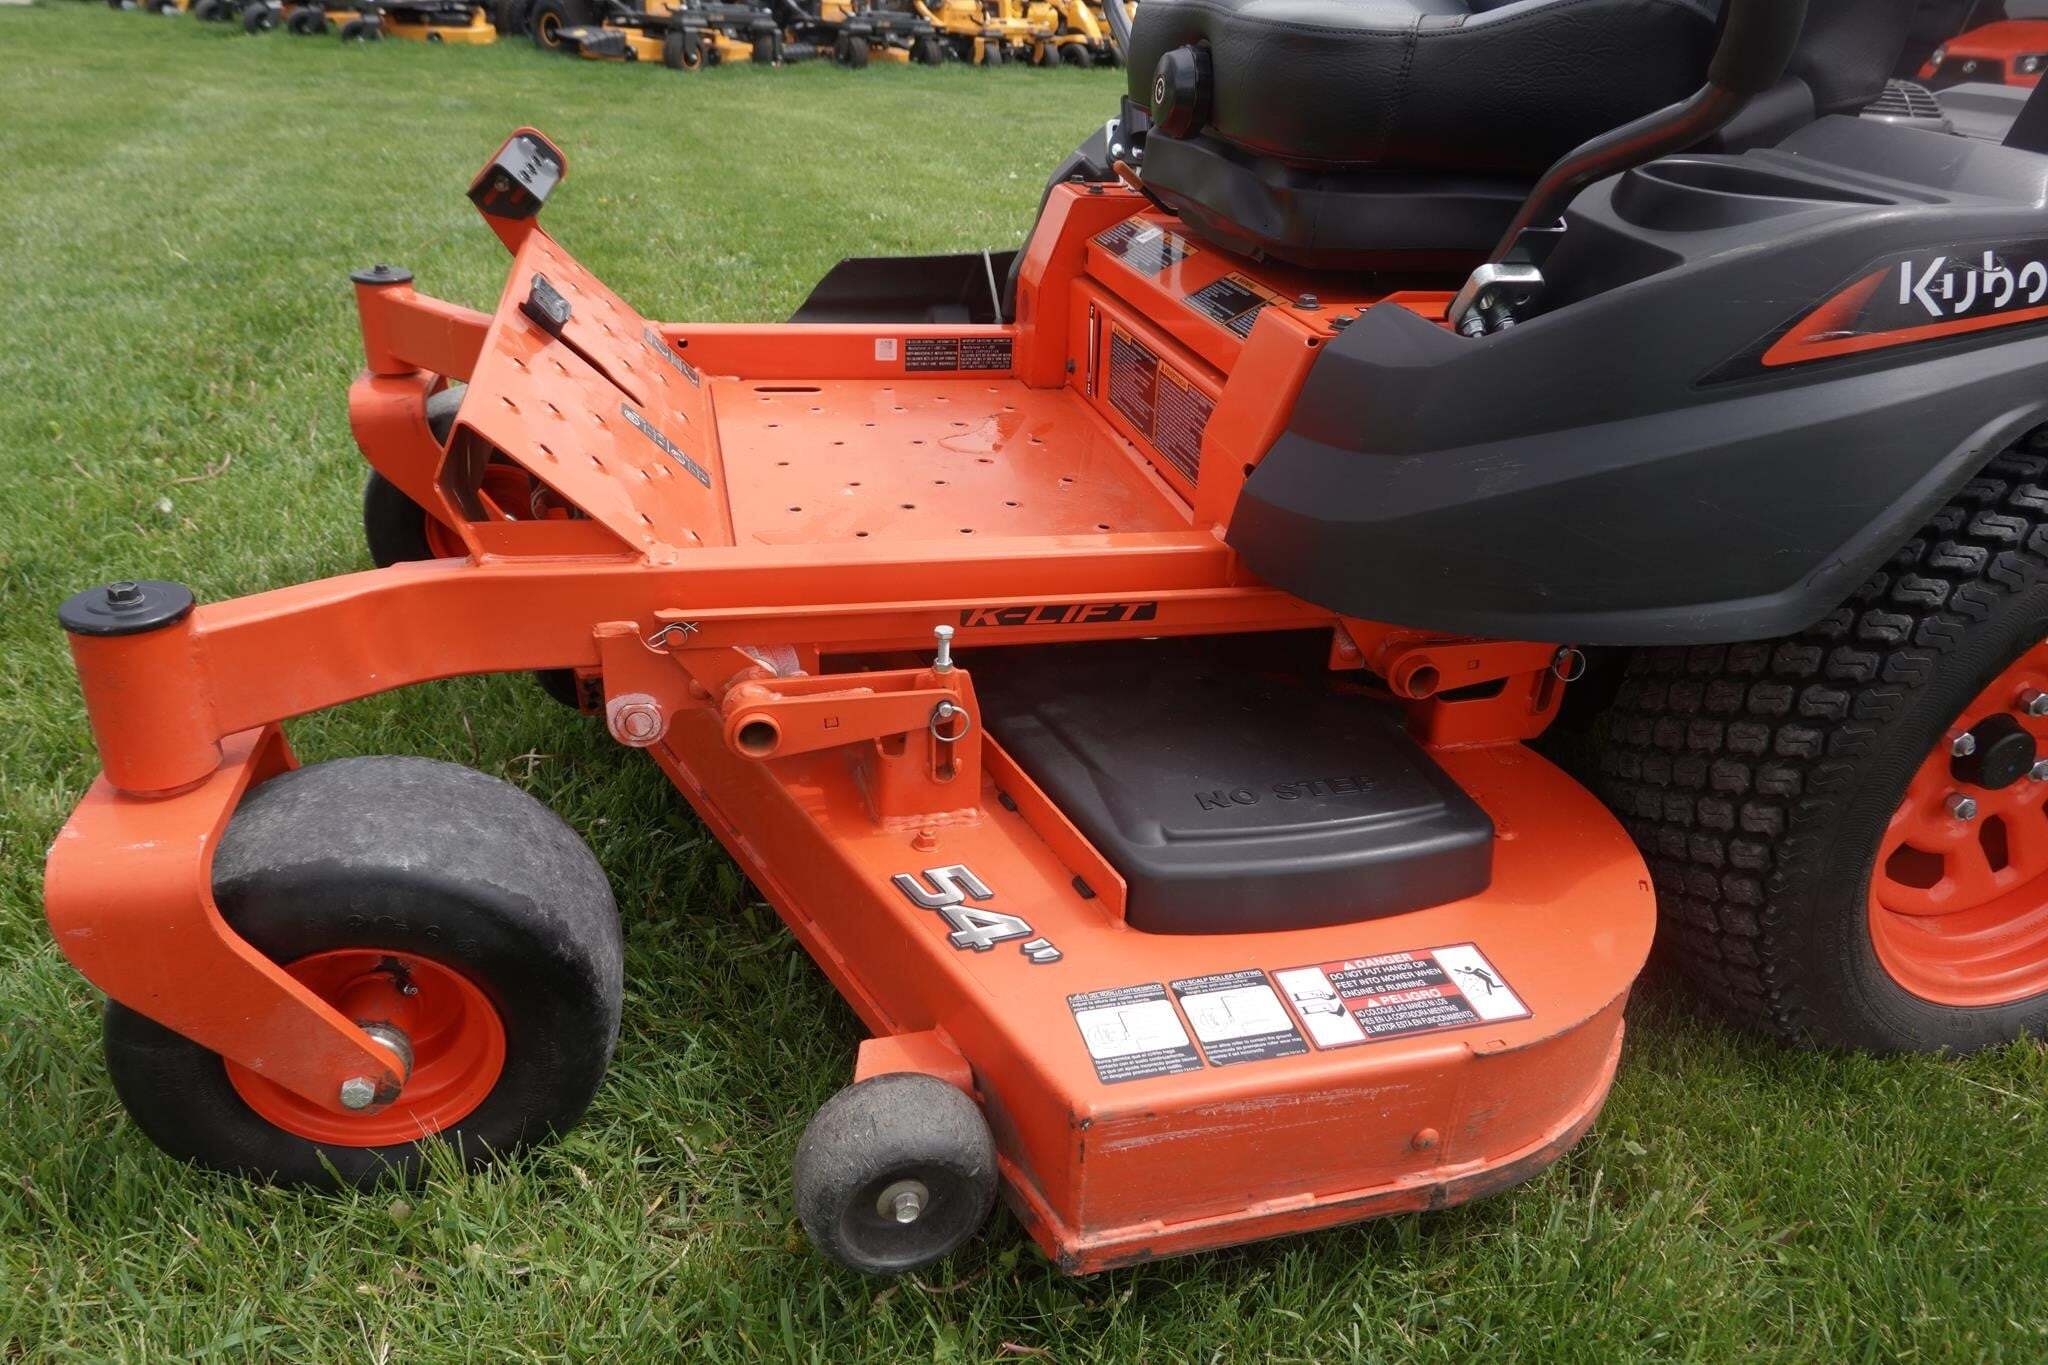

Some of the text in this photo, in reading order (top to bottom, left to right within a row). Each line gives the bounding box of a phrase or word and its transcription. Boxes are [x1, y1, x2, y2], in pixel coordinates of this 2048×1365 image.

[964, 603, 1154, 628] K-LIFT
[1194, 776, 1377, 812] NO STEP
[1354, 954, 1413, 967] DANGER
[1382, 963, 1413, 972] HANDS
[1209, 973, 1234, 981] ROLLER
[1335, 980, 1358, 988] FEET
[1380, 972, 1415, 981] MOWER
[1415, 968, 1442, 977] WHEN
[1341, 987, 1375, 996] ENGINE
[1379, 989, 1442, 1004] PELIGRO
